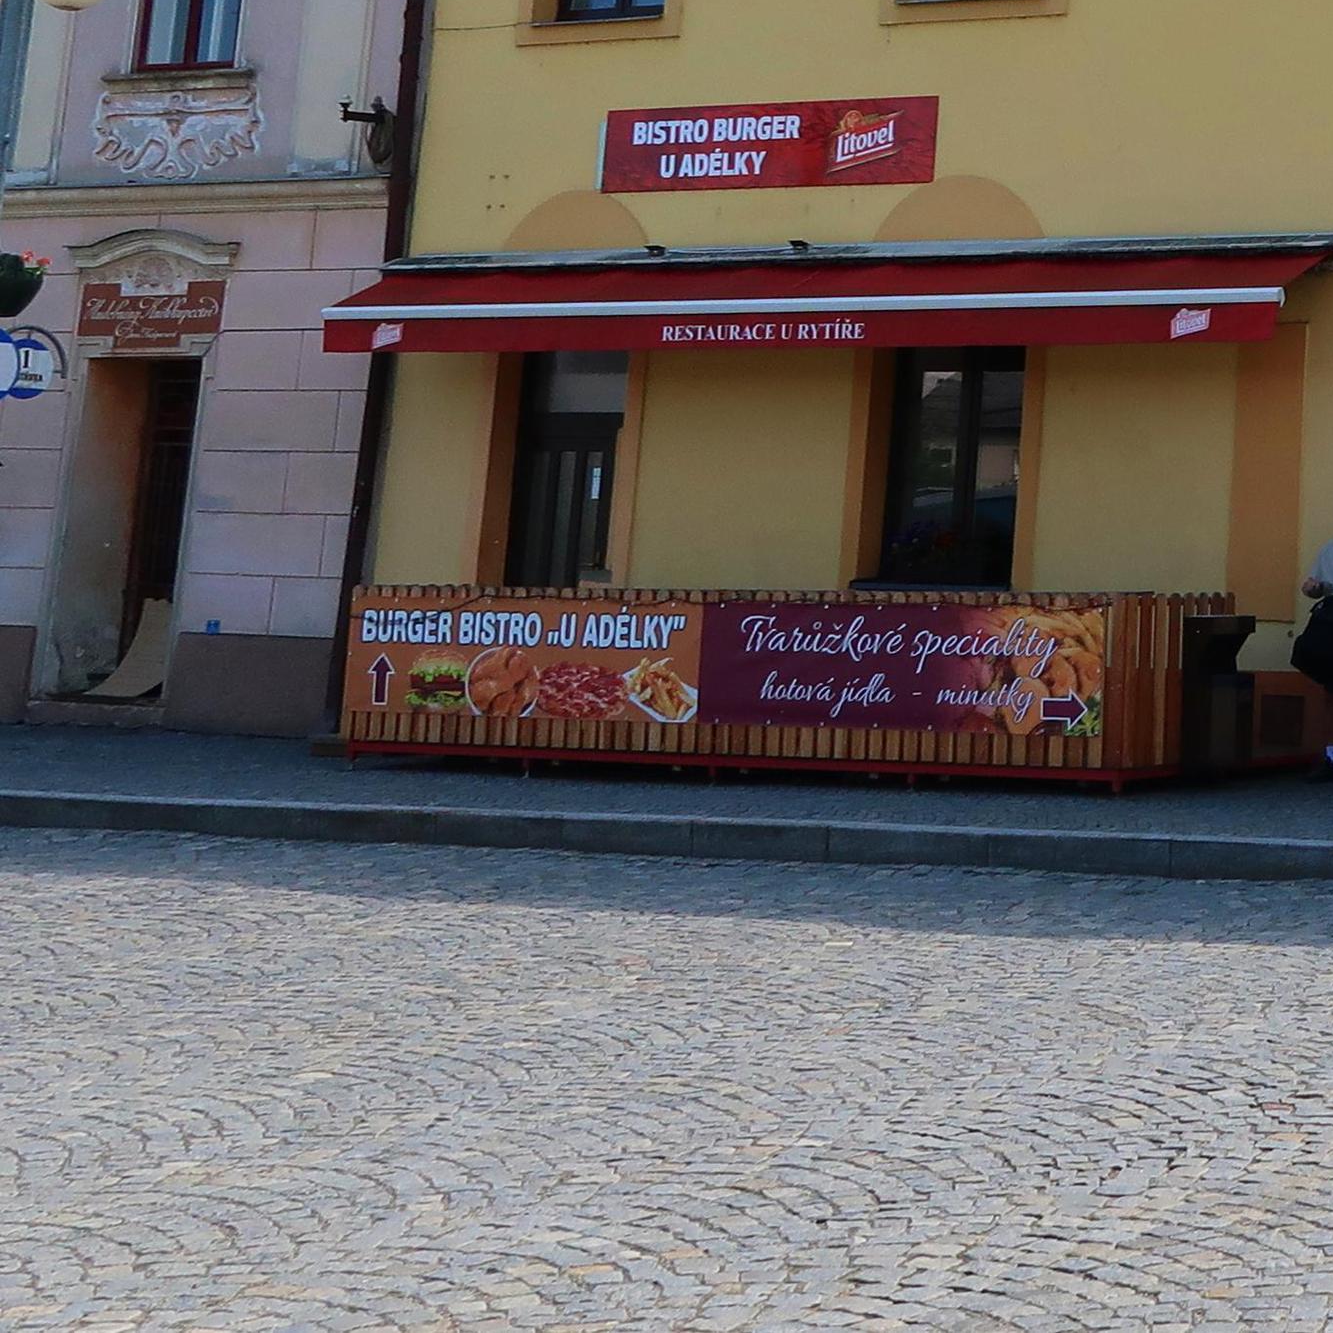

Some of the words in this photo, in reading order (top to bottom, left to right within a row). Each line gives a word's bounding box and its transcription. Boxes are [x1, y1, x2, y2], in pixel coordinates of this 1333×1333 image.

[632, 119, 708, 145] BISTRO
[712, 114, 801, 142] BURGER
[836, 119, 896, 162] Litovel
[659, 154, 676, 178] U
[678, 148, 767, 177] ADÉLKY
[661, 323, 776, 342] RESTAURACE
[780, 323, 793, 340] U
[797, 318, 865, 340] RYTÍŘE
[361, 609, 452, 643] BURGER
[458, 611, 542, 646] BISTRO
[740, 614, 905, 662] Tvarůžkové
[910, 618, 1058, 678] speciality
[760, 670, 835, 702] hotová
[830, 673, 895, 718] jídla
[935, 677, 1035, 722] minutky
